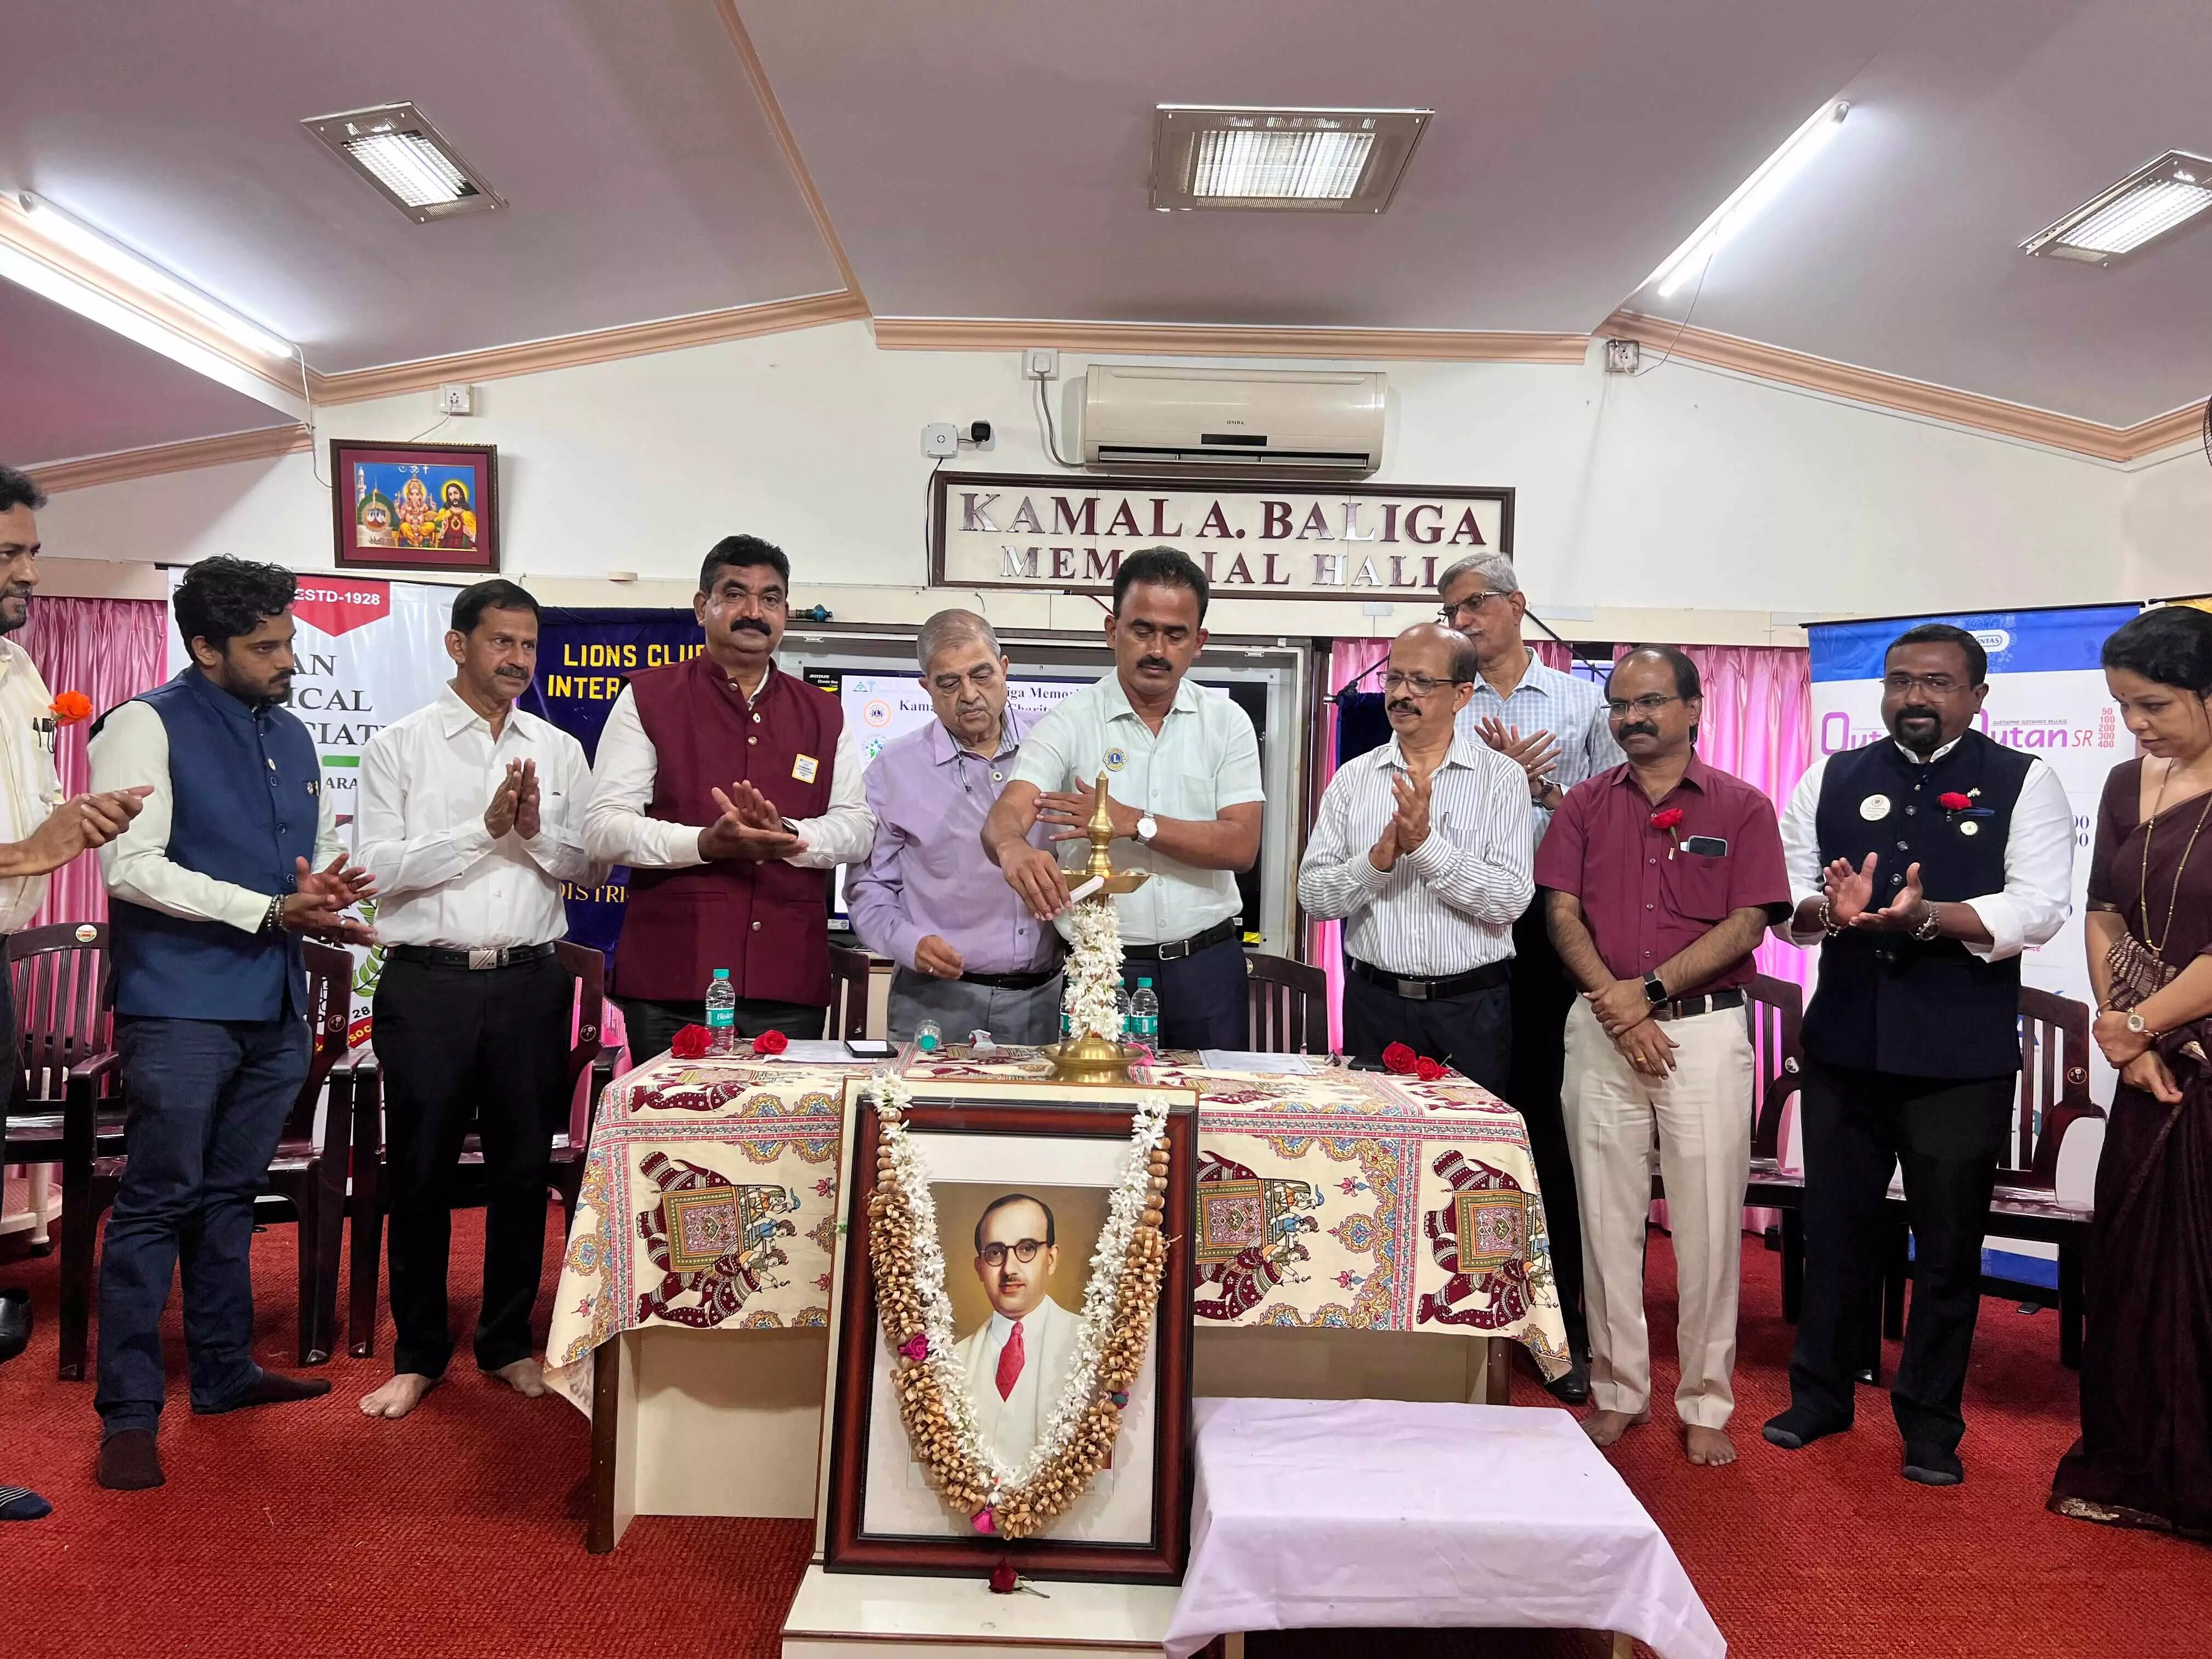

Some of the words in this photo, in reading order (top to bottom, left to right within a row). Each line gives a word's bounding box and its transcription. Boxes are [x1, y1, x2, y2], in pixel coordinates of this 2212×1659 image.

[958, 492, 1183, 537] KAMAL
[1195, 500, 1246, 539] A.
[1259, 500, 1487, 545] BALIGA
[1000, 545, 1291, 585] MEMIAL
[294, 588, 381, 606] ESTD-1928
[293, 652, 338, 676] AN
[563, 644, 637, 667] LIONS
[548, 674, 620, 699] INTER
[1007, 686, 1024, 700] iga
[1030, 687, 1079, 698] Memo
[283, 687, 374, 712] ICAL
[2102, 707, 2113, 715] 50
[304, 721, 387, 746] IAT
[2071, 730, 2094, 747] SR
[326, 777, 357, 789] ARA
[348, 1024, 372, 1045] SOC
